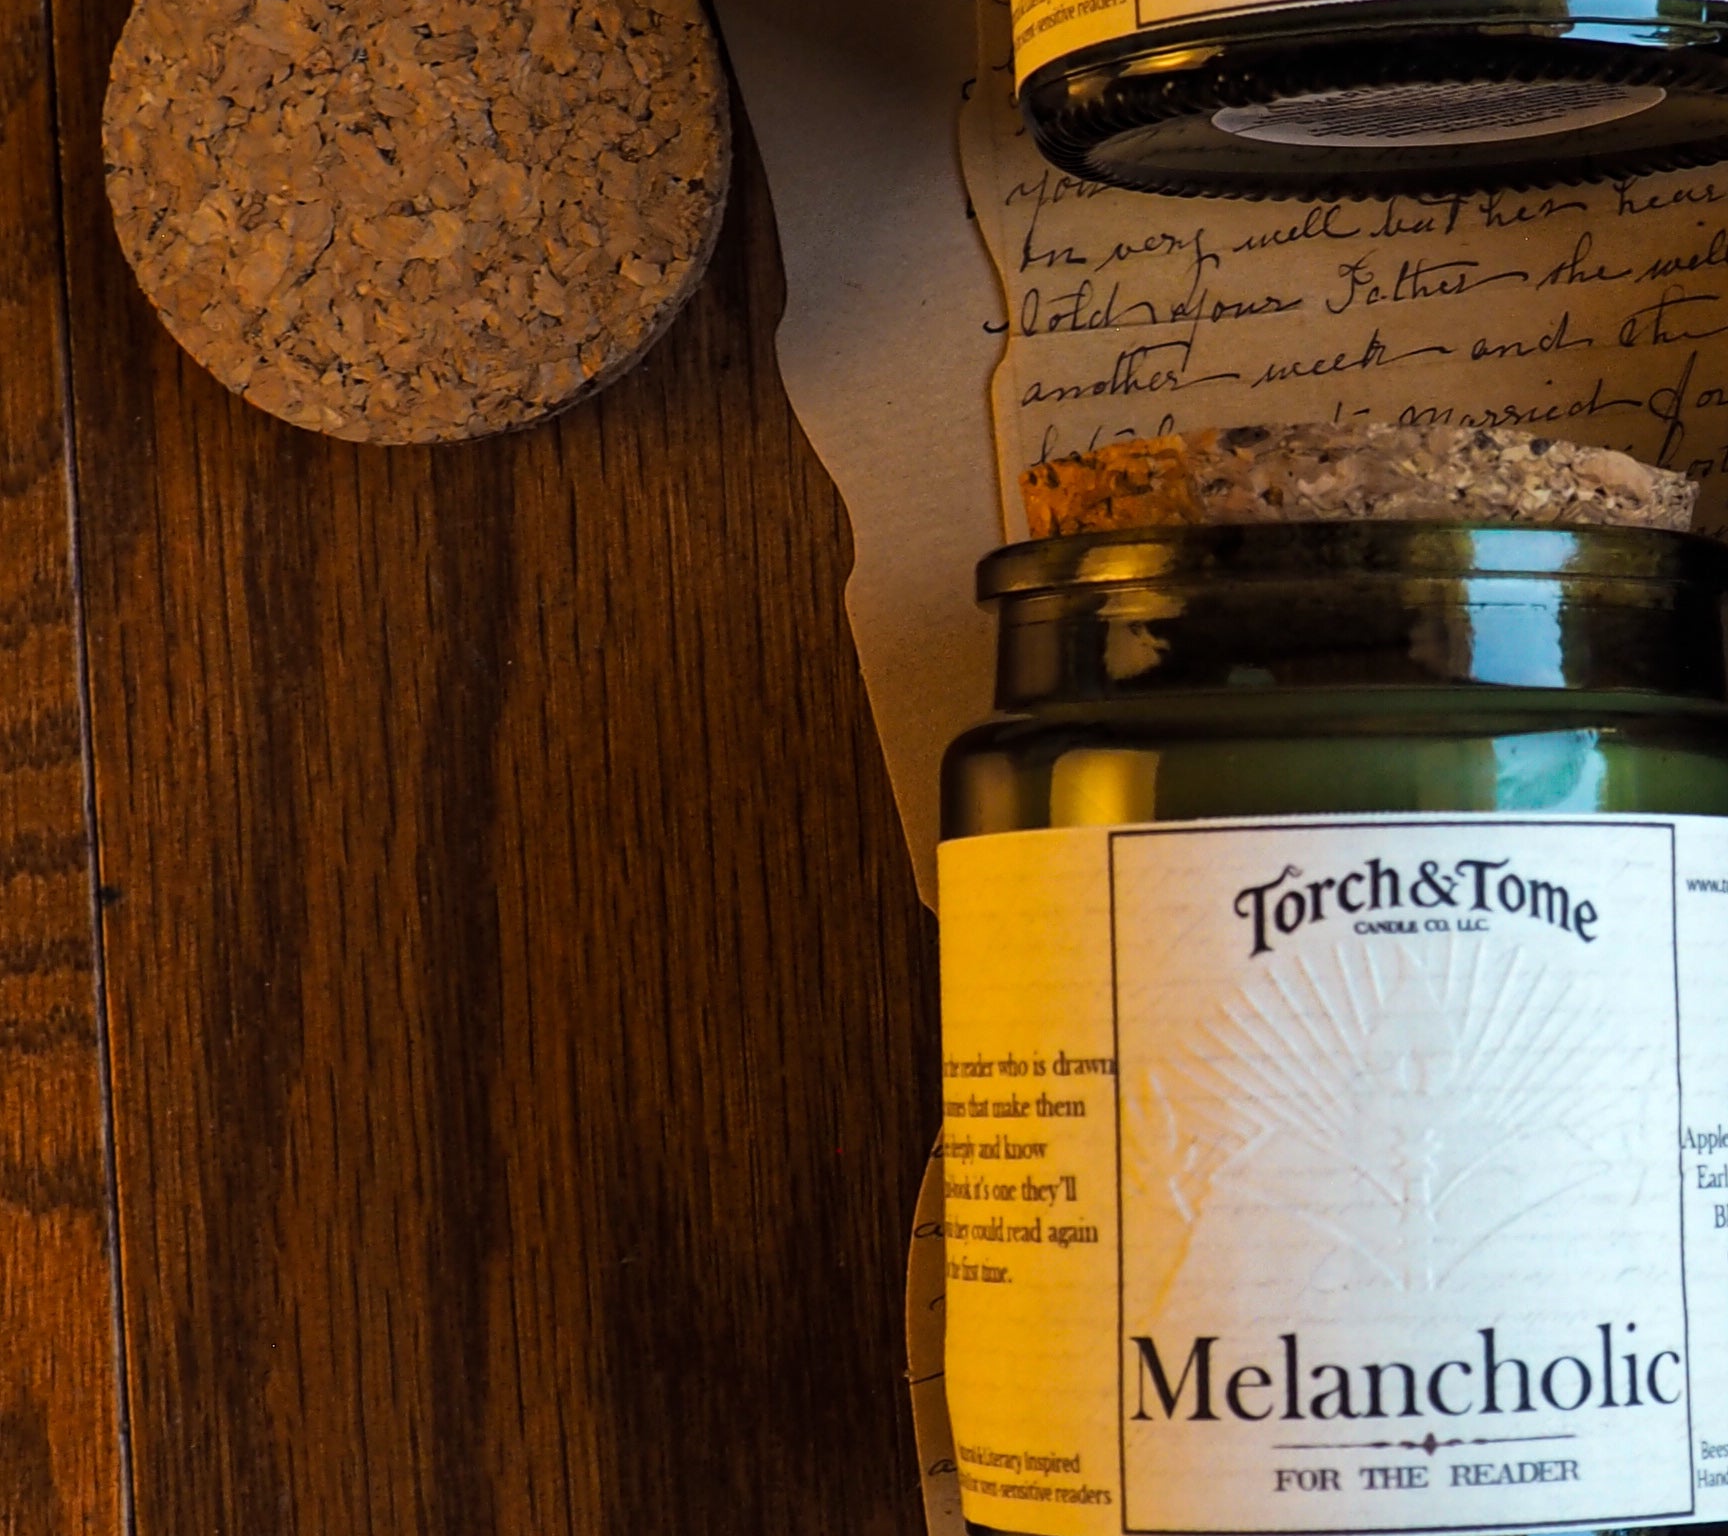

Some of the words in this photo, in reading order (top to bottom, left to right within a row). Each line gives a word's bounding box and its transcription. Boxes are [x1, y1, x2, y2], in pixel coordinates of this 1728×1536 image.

[1021, 340, 1240, 408] another
[1471, 311, 1594, 362] and
[1353, 918, 1419, 936] CANDLE
[1424, 917, 1451, 934] CO.
[997, 1051, 1028, 1077] who
[1033, 1050, 1047, 1076] is
[1053, 1049, 1118, 1077] drawn
[992, 1092, 1031, 1118] make
[1036, 1091, 1086, 1117] them
[1004, 1134, 1048, 1159] know
[1697, 1162, 1728, 1189] Earl
[992, 1182, 1017, 1201] one
[1021, 1175, 1077, 1208] they'll
[1007, 1217, 1042, 1243] read
[1048, 1216, 1099, 1249] again
[1129, 1321, 1683, 1422] Melancholic
[1024, 1451, 1081, 1477] Inspired
[1274, 1467, 1342, 1492] FOR
[1360, 1465, 1429, 1489] THE
[1449, 1459, 1581, 1487] READER
[1055, 1484, 1113, 1505] readers
